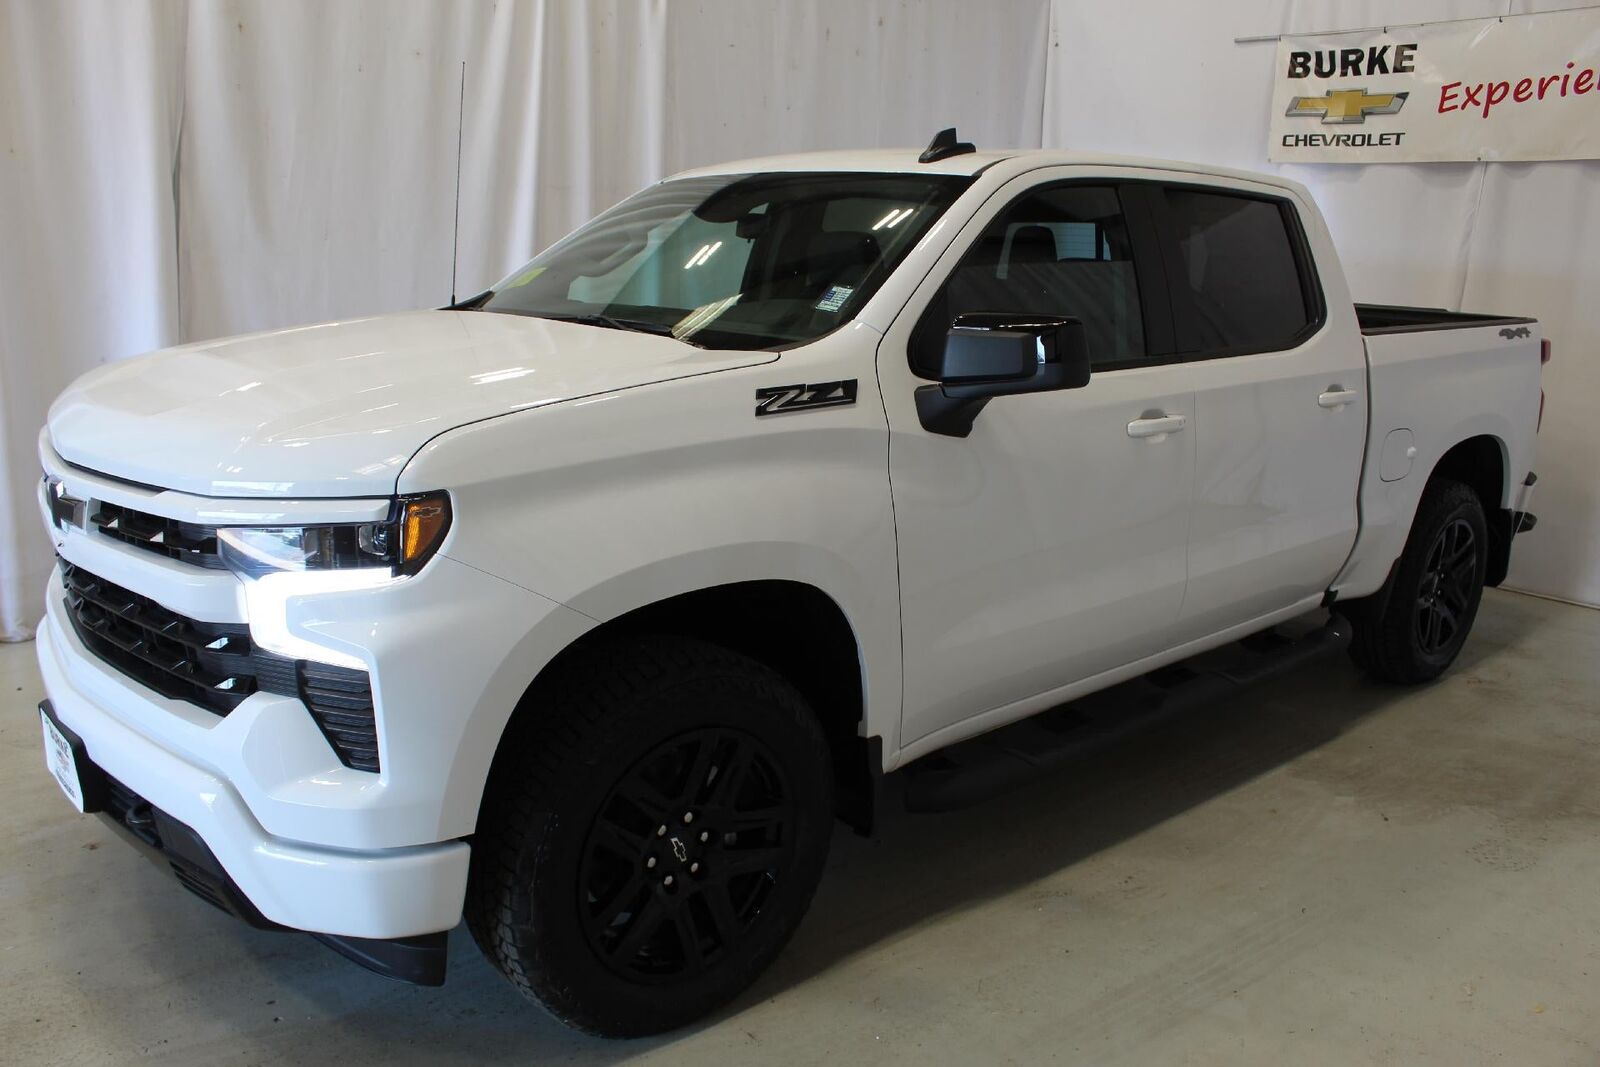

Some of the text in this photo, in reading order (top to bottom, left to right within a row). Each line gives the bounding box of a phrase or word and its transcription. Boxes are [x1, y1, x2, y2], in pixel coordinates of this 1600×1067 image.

[1287, 44, 1418, 79] BURKE
[1438, 62, 1600, 118] Experie
[1282, 132, 1406, 147] CHEVROLET
[755, 379, 858, 416] Z71
